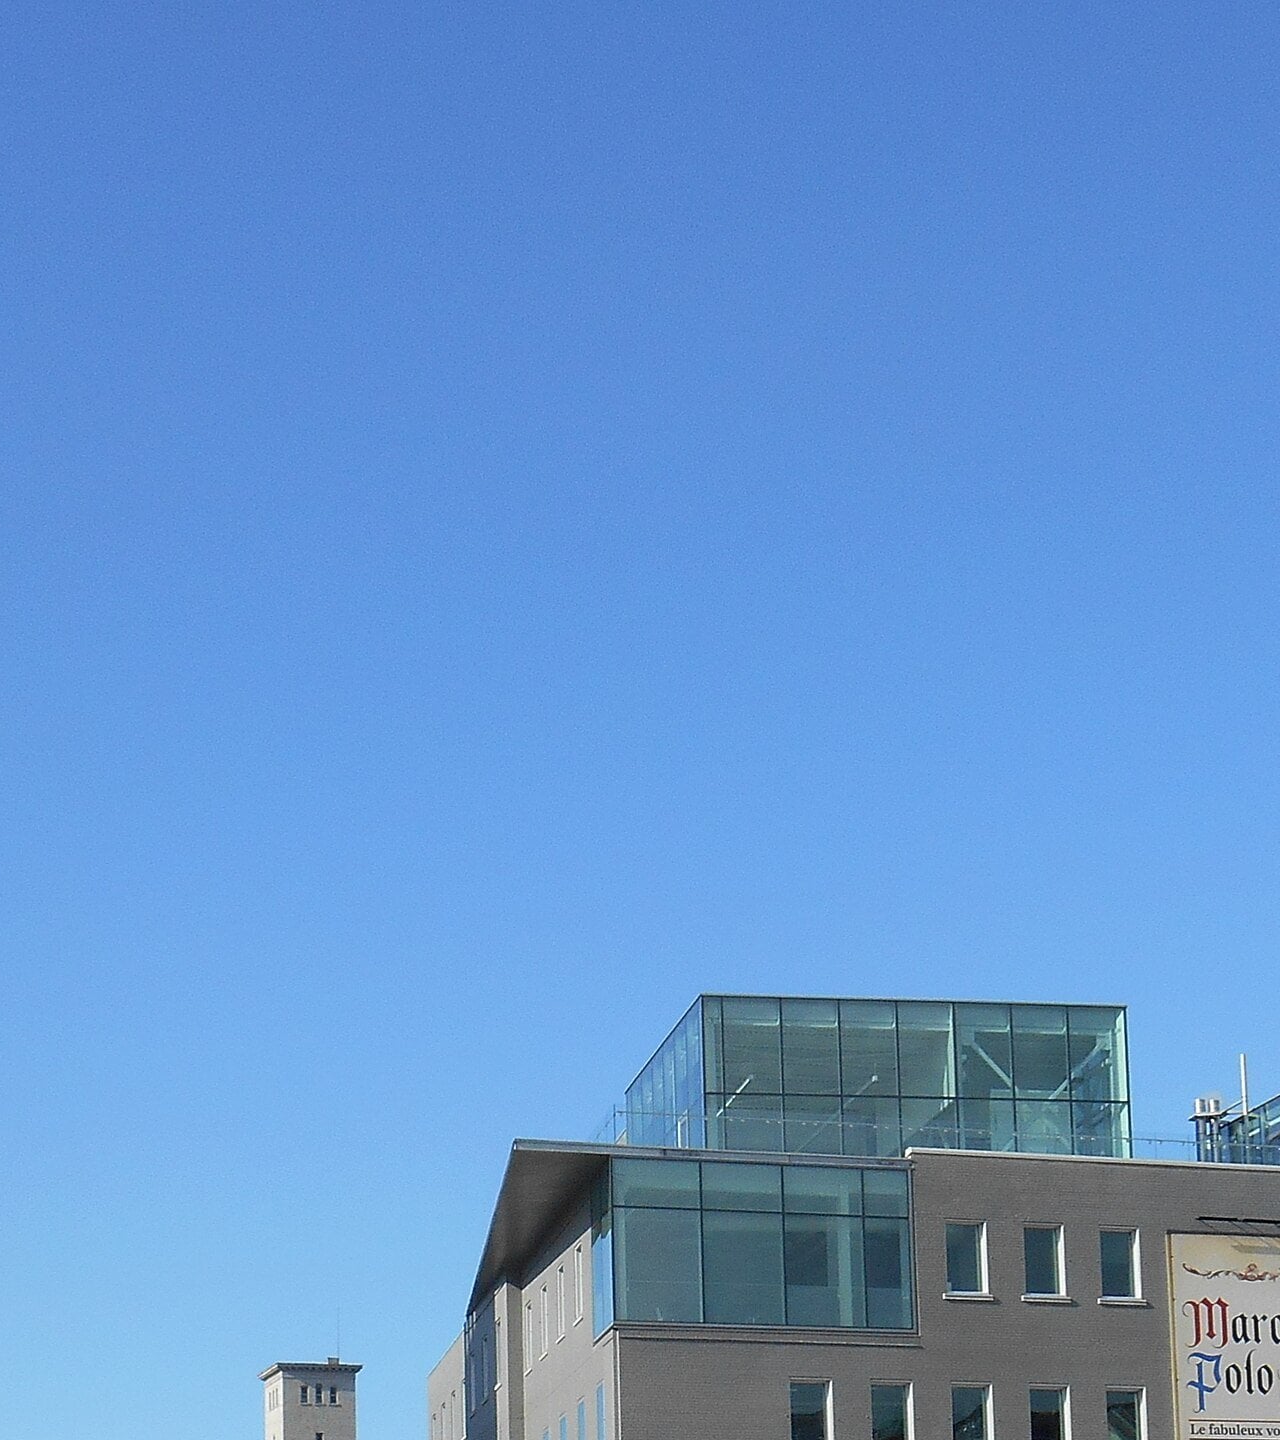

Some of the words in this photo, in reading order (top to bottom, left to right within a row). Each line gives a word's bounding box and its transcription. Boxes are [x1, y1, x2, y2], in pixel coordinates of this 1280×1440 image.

[1186, 1349, 1274, 1414] Polo
[1190, 1423, 1206, 1435] Le
[1209, 1423, 1263, 1436] fabuleux
